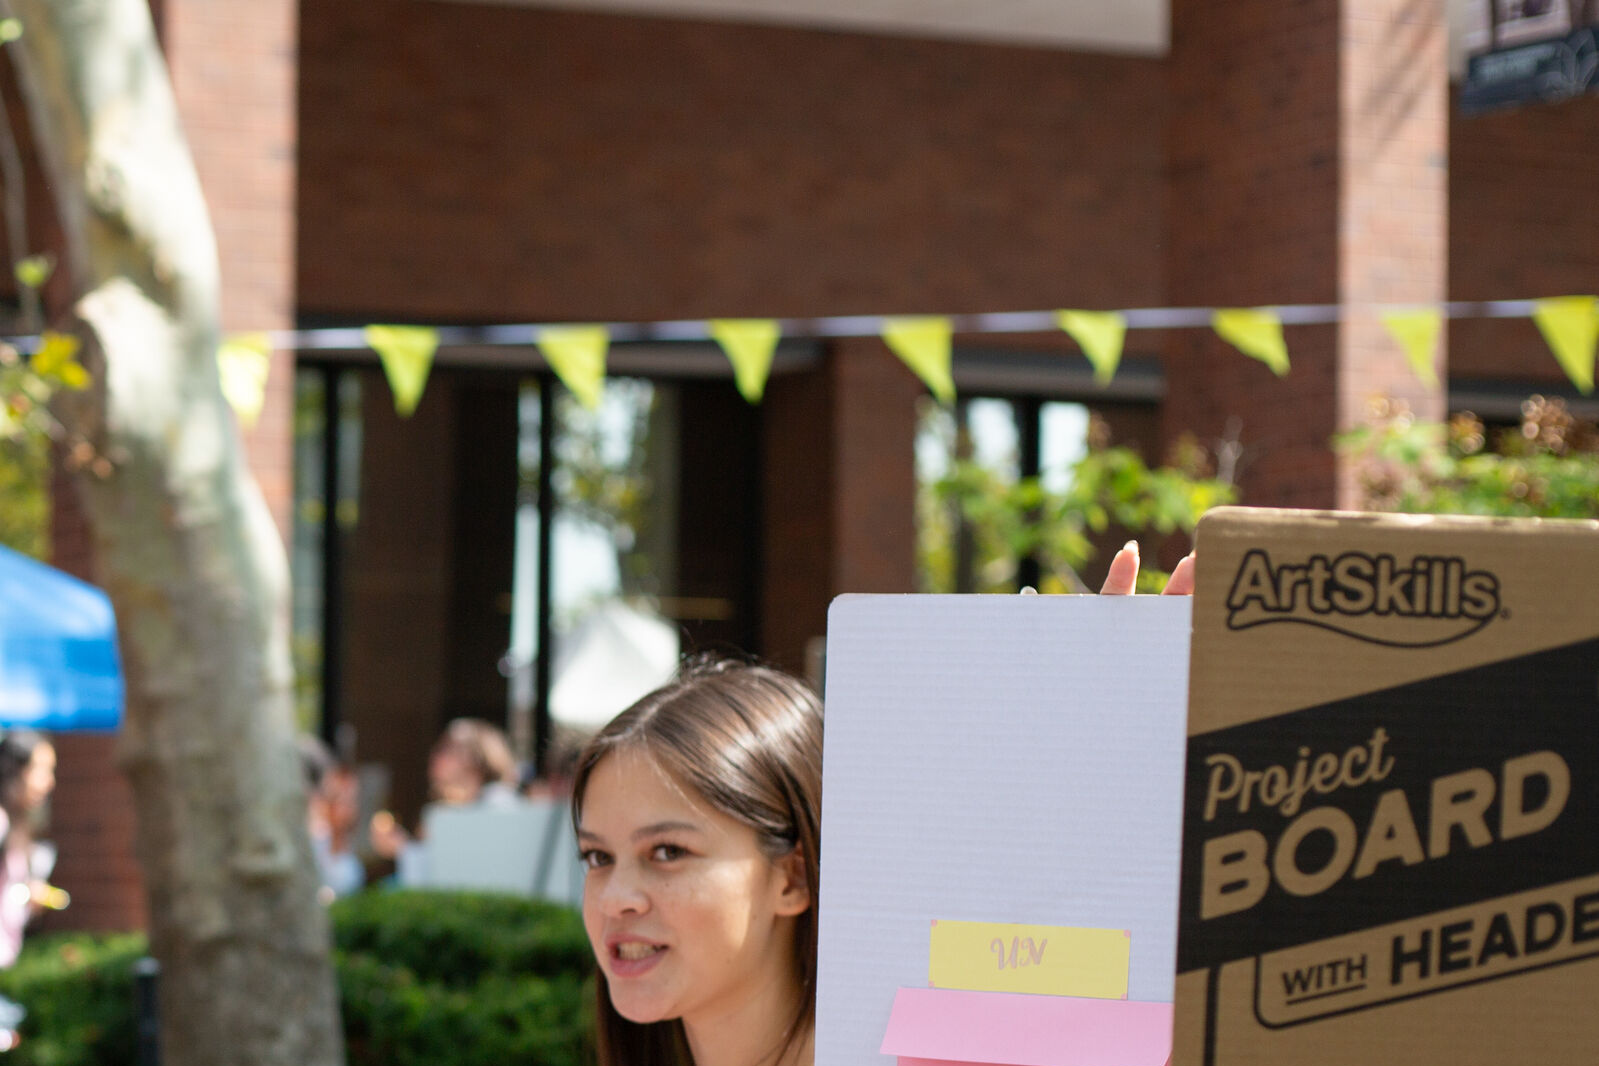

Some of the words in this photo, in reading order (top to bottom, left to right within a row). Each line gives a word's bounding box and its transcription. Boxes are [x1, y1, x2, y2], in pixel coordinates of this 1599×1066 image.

[1226, 549, 1501, 622] ArtSkills
[1203, 728, 1395, 822] Project
[1203, 750, 1571, 921] BOARD
[1282, 954, 1368, 997] WITH
